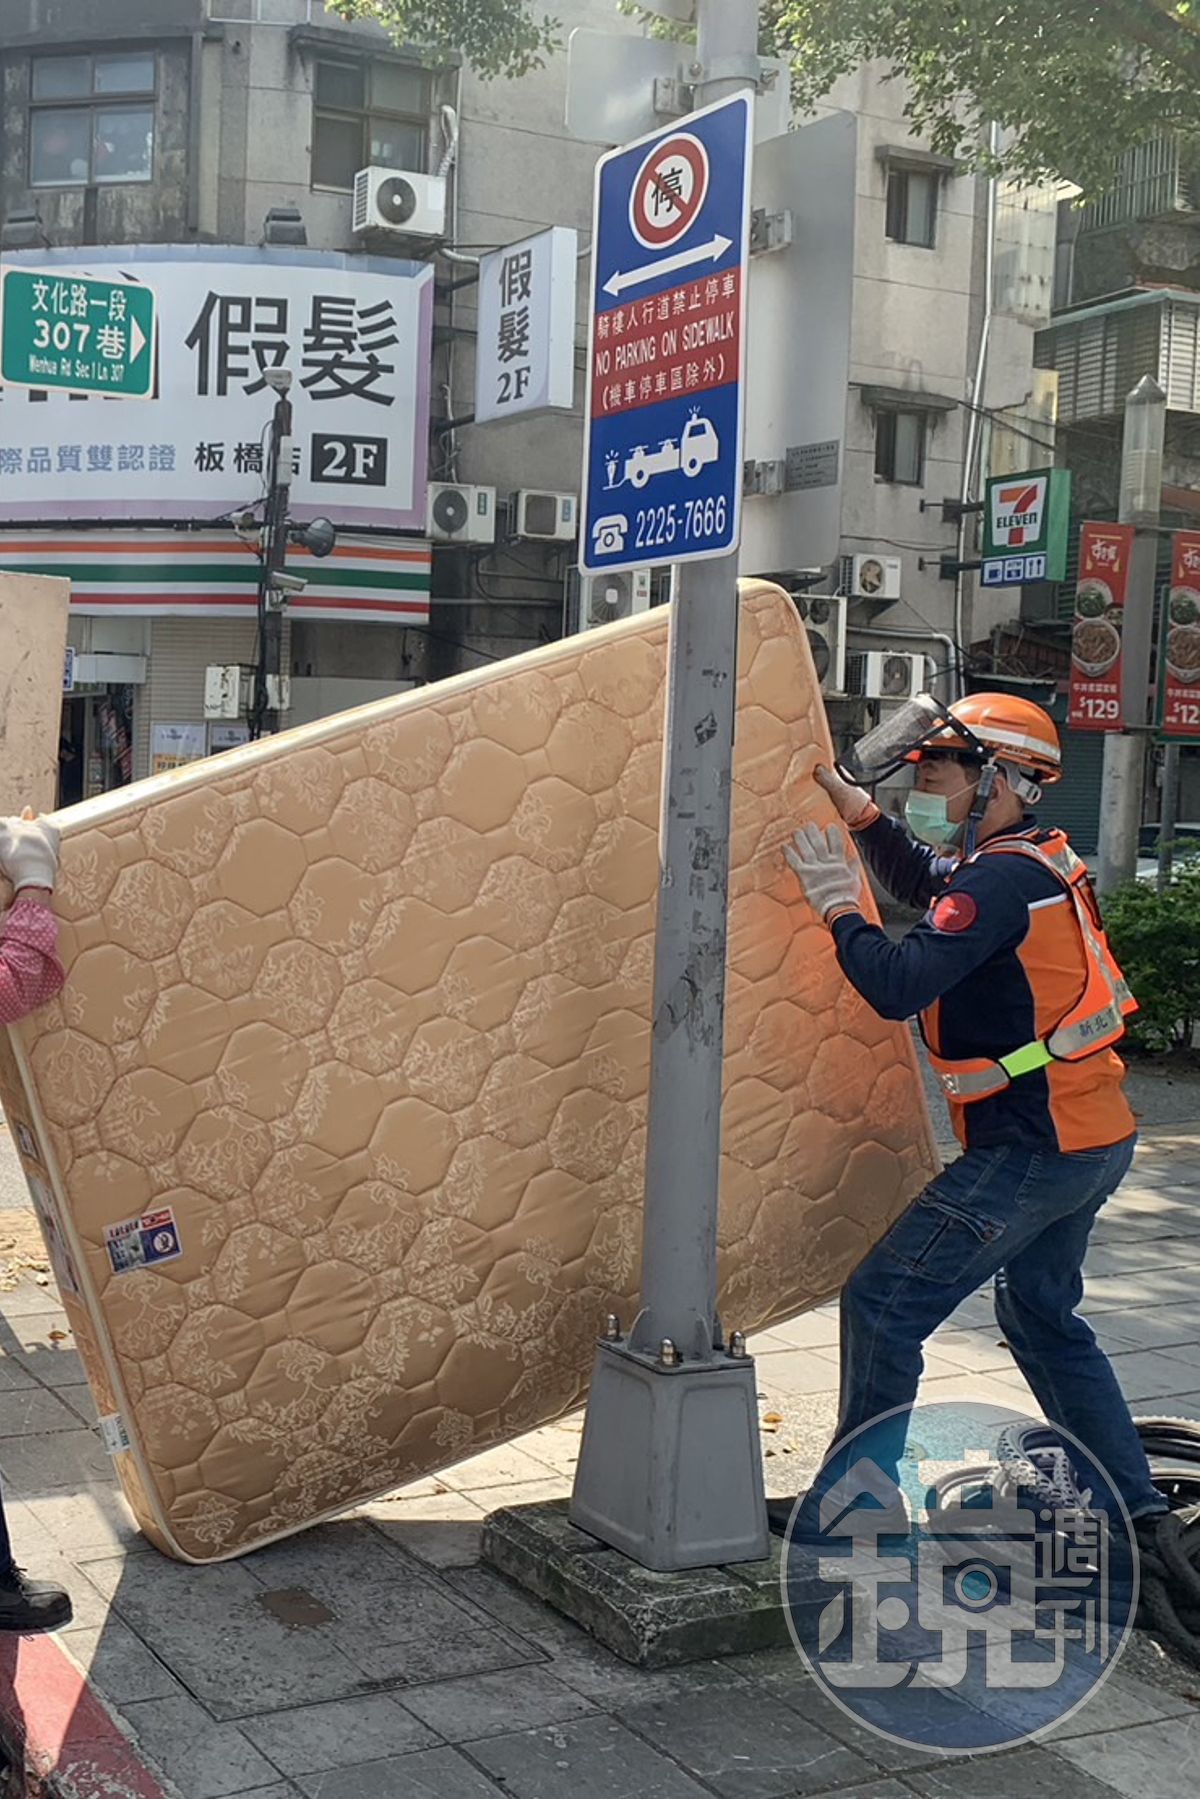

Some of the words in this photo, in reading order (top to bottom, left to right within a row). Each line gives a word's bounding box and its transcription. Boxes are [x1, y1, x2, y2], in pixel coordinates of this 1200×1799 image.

[650, 166, 682, 217] 停
[31, 279, 127, 322] 文化路一段
[496, 248, 533, 363] 假髮
[597, 273, 736, 340] 騎樓人行道禁止停車
[33, 319, 91, 353] 307
[96, 324, 126, 359] 巷
[185, 290, 399, 406] 假髮
[595, 350, 610, 377] NO
[615, 335, 656, 371] PARKING
[661, 329, 677, 357] ON
[682, 311, 735, 351] SIDEWALK
[29, 354, 57, 376] Wenhua
[60, 357, 72, 377] Rd
[75, 360, 90, 379] Sec
[97, 362, 108, 381] Ln
[111, 363, 125, 383] 307
[496, 366, 531, 405] 2F
[194, 442, 301, 475] 板橋
[322, 441, 377, 478] 2F
[634, 495, 727, 548] 2225-7666
[999, 484, 1038, 545] 7
